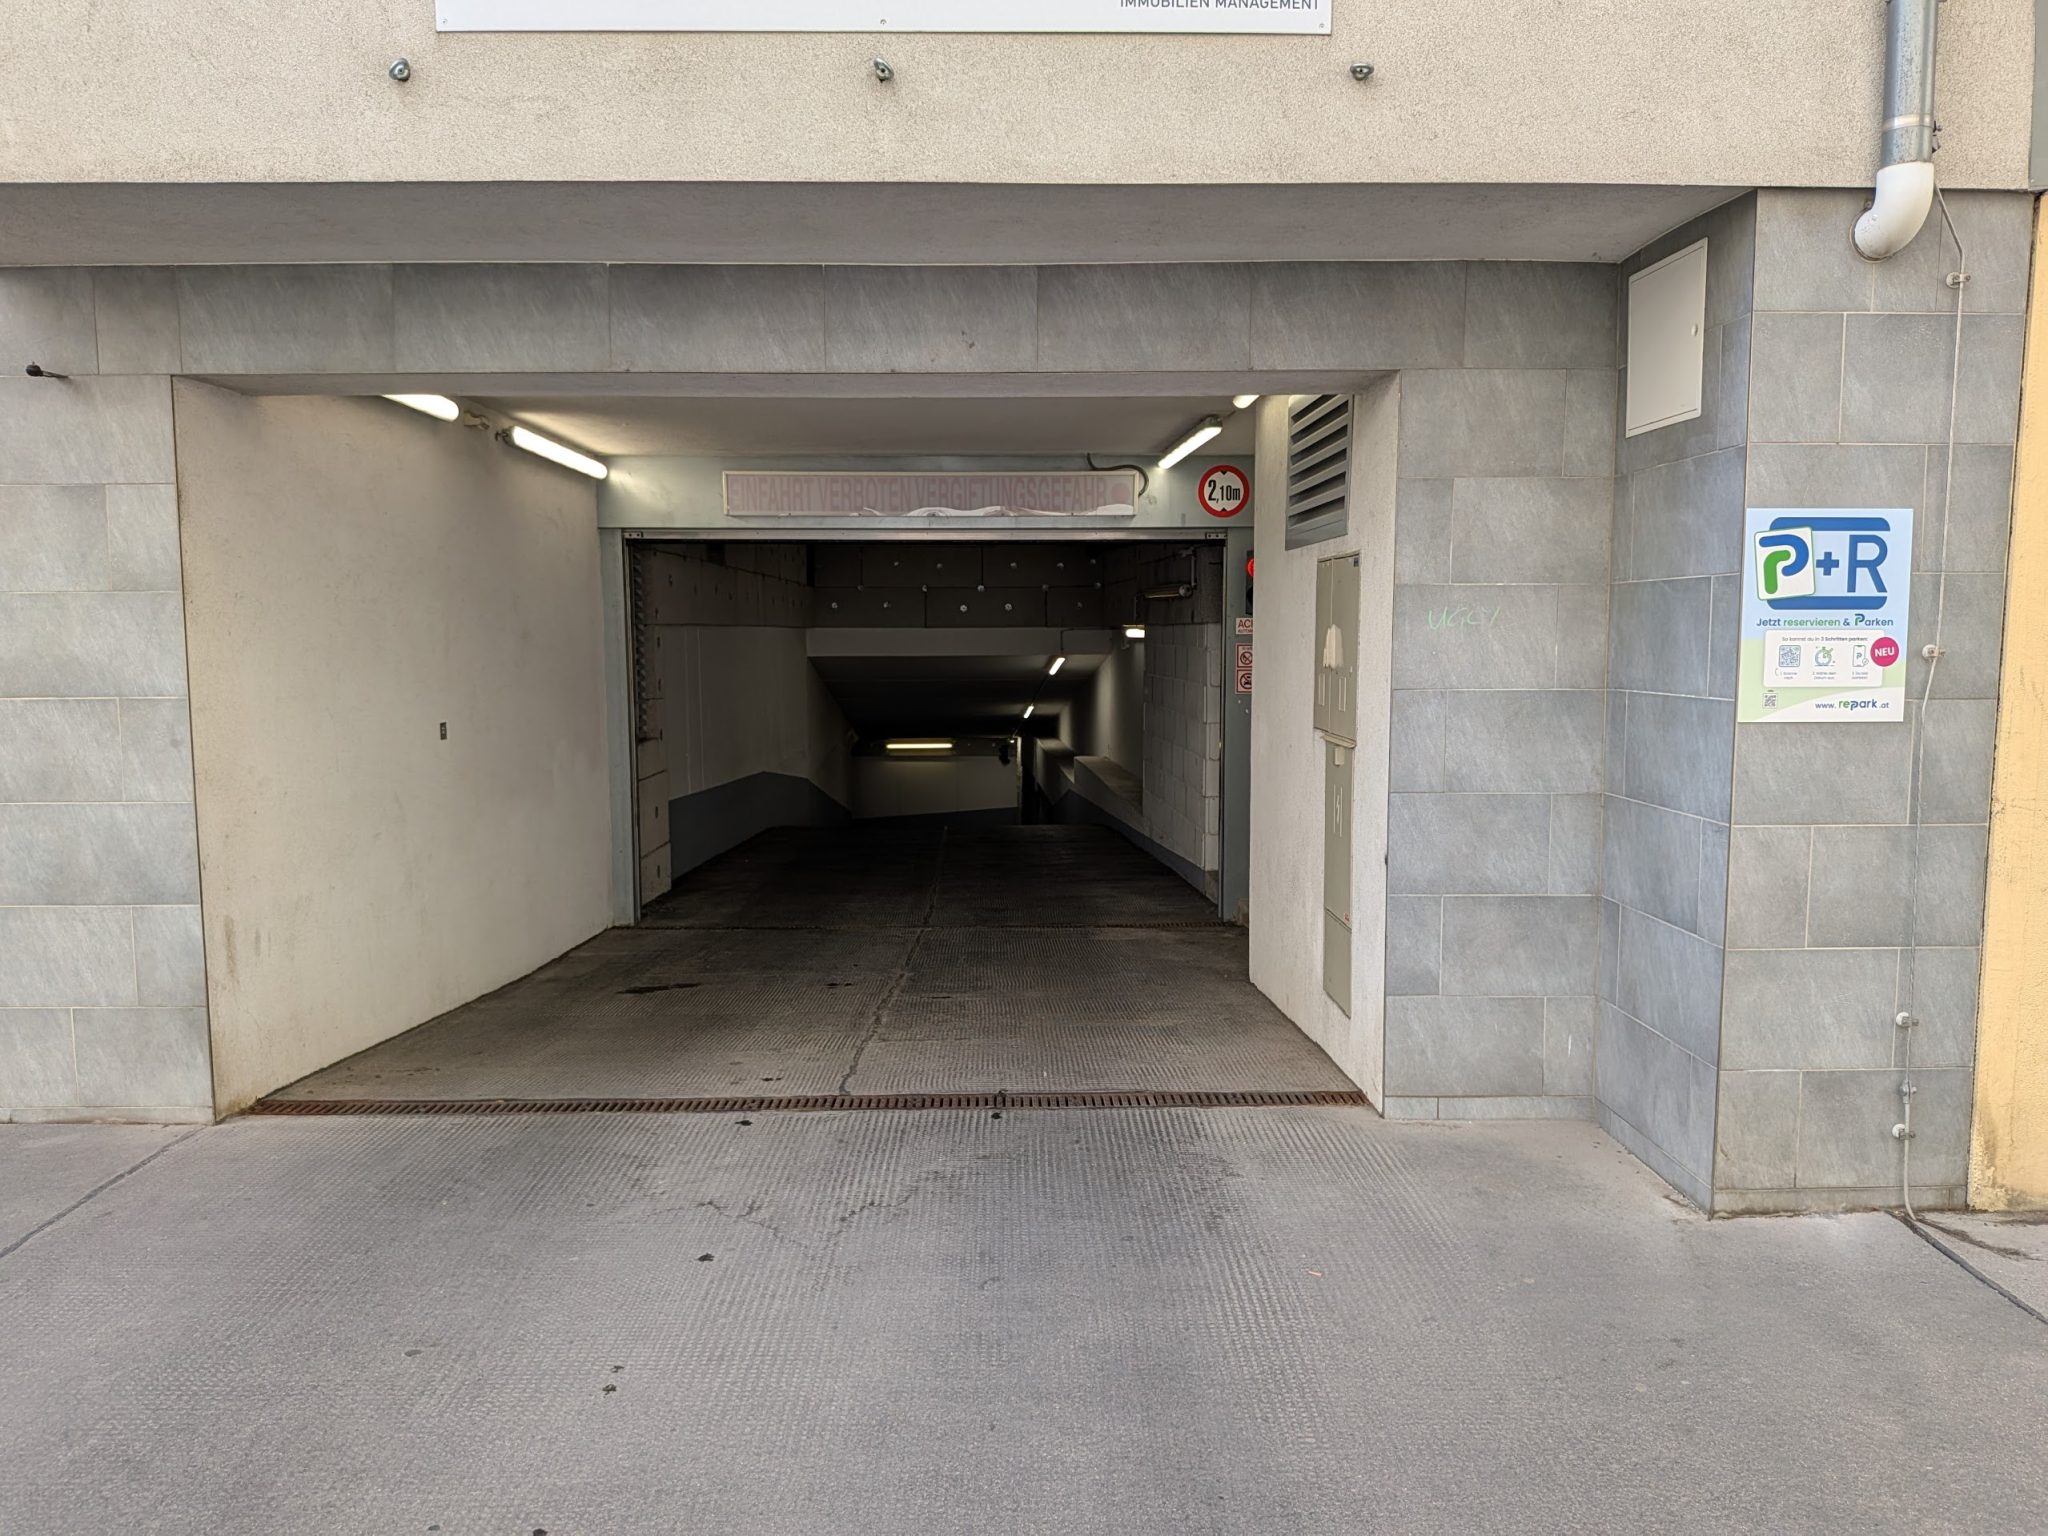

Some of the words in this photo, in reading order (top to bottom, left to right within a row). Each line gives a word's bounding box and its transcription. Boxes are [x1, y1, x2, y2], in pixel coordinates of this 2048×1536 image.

[1120, 0, 1210, 8] IMMOBILIEN
[1215, 0, 1318, 10] MANAGEMENT
[730, 477, 816, 512] EINFAHRT
[818, 477, 912, 512] VERBOTEN
[915, 476, 1106, 511] VERGIFTUNGSGEFAHR
[1208, 480, 1241, 503] 2,10m
[1756, 617, 1781, 627] Jetzt
[1783, 616, 1841, 627] reservieren
[1843, 617, 1851, 627] &
[1854, 613, 1894, 627] Parken
[1874, 646, 1894, 657] NEU
